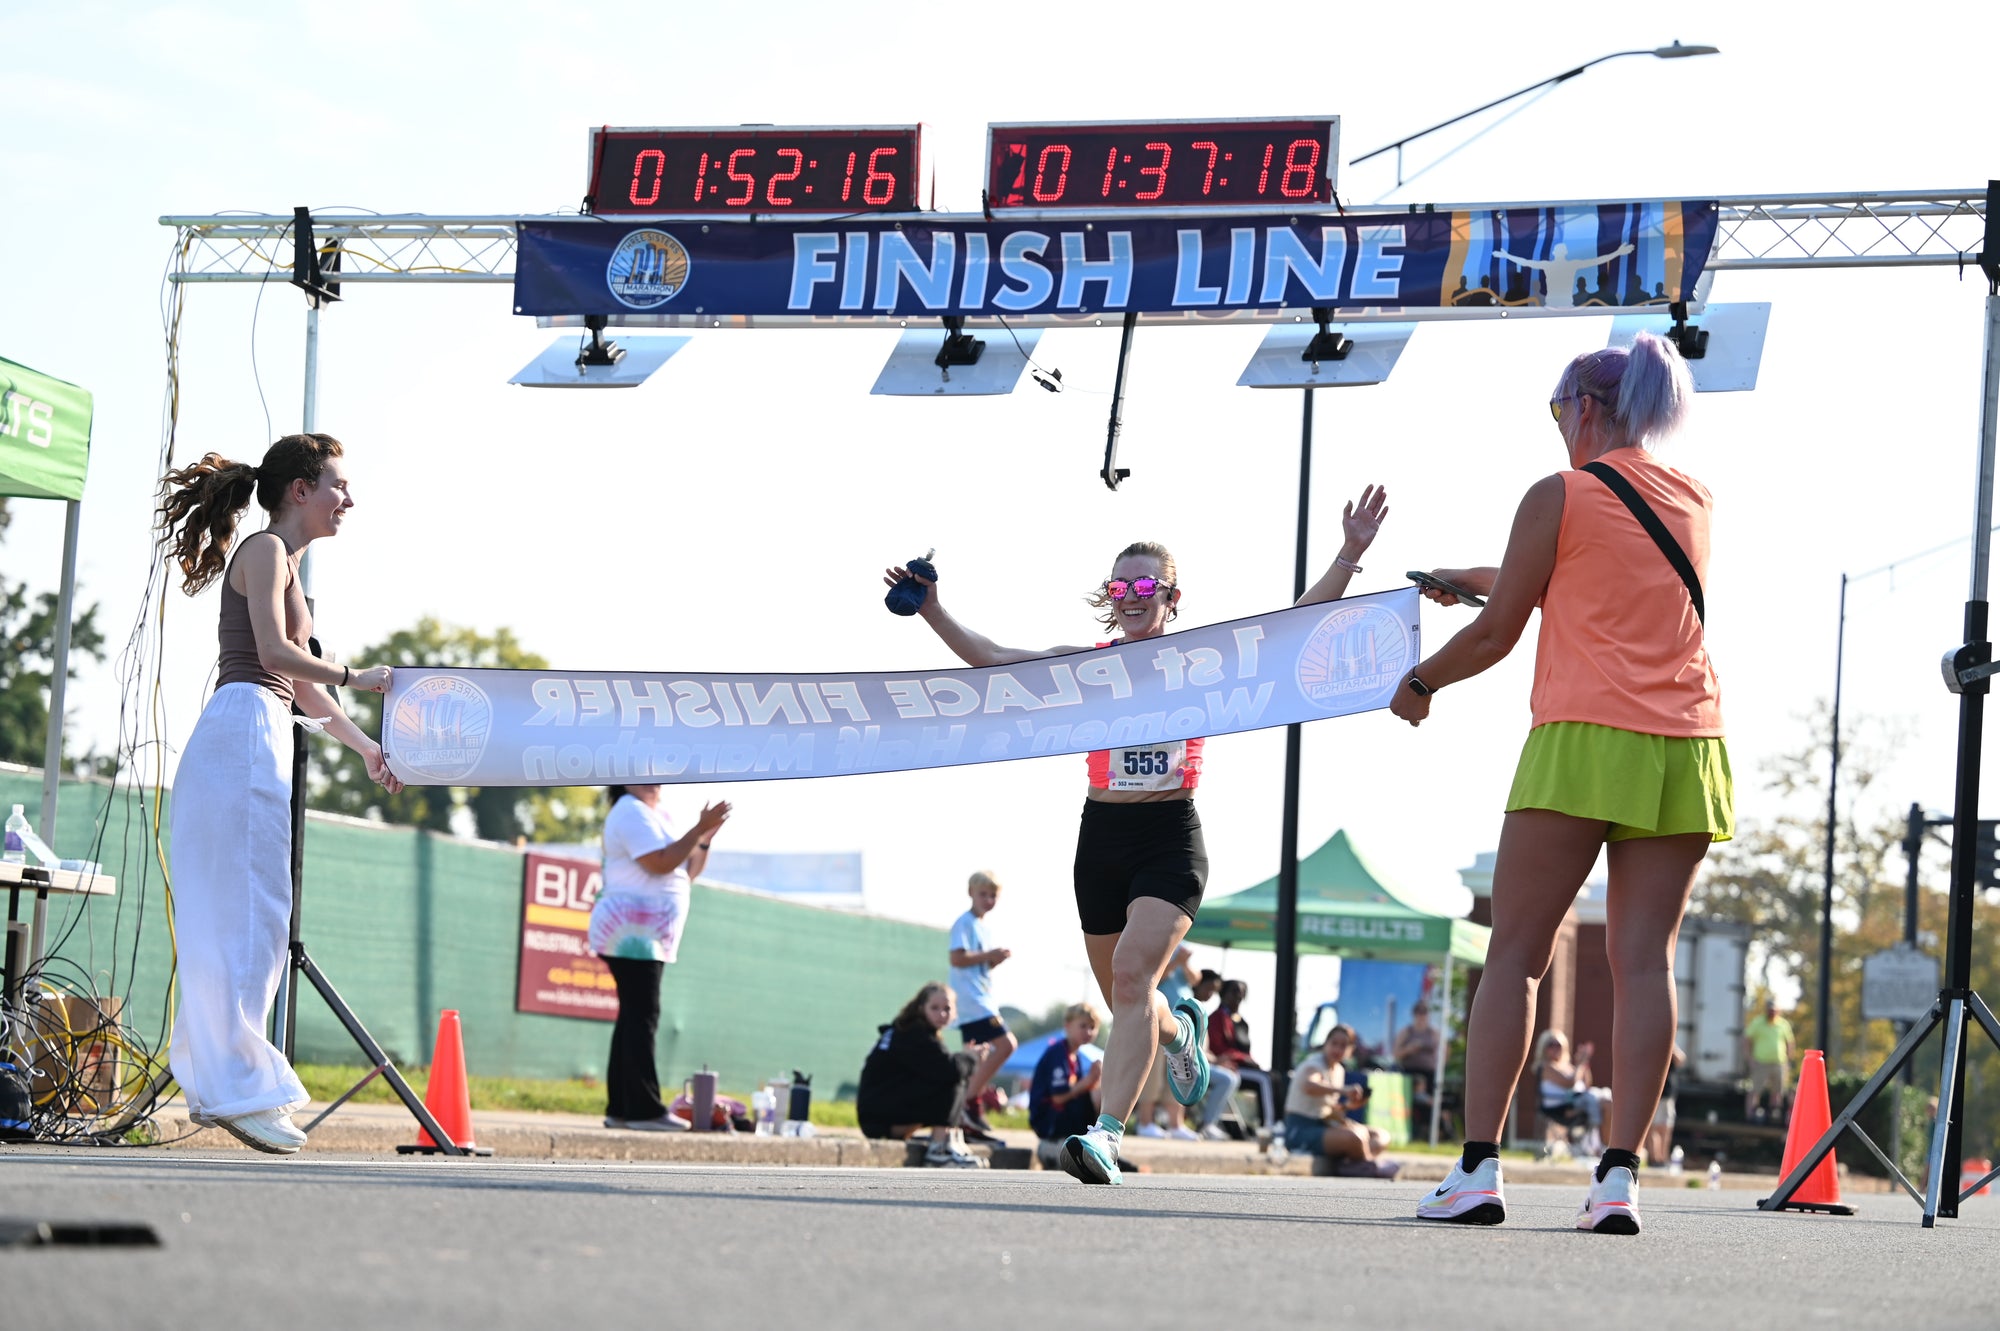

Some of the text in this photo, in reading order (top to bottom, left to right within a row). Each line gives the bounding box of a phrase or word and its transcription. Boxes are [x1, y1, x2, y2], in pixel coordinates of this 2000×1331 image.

[629, 147, 898, 206] 01:52:16
[1032, 138, 1320, 202] 01:37:18
[622, 232, 681, 255] THREE SISTERS
[787, 224, 1406, 310] FINISH LINE
[626, 284, 672, 292] MARATHON
[1123, 751, 1169, 775] 553
[1301, 915, 1425, 941] RESULTS
